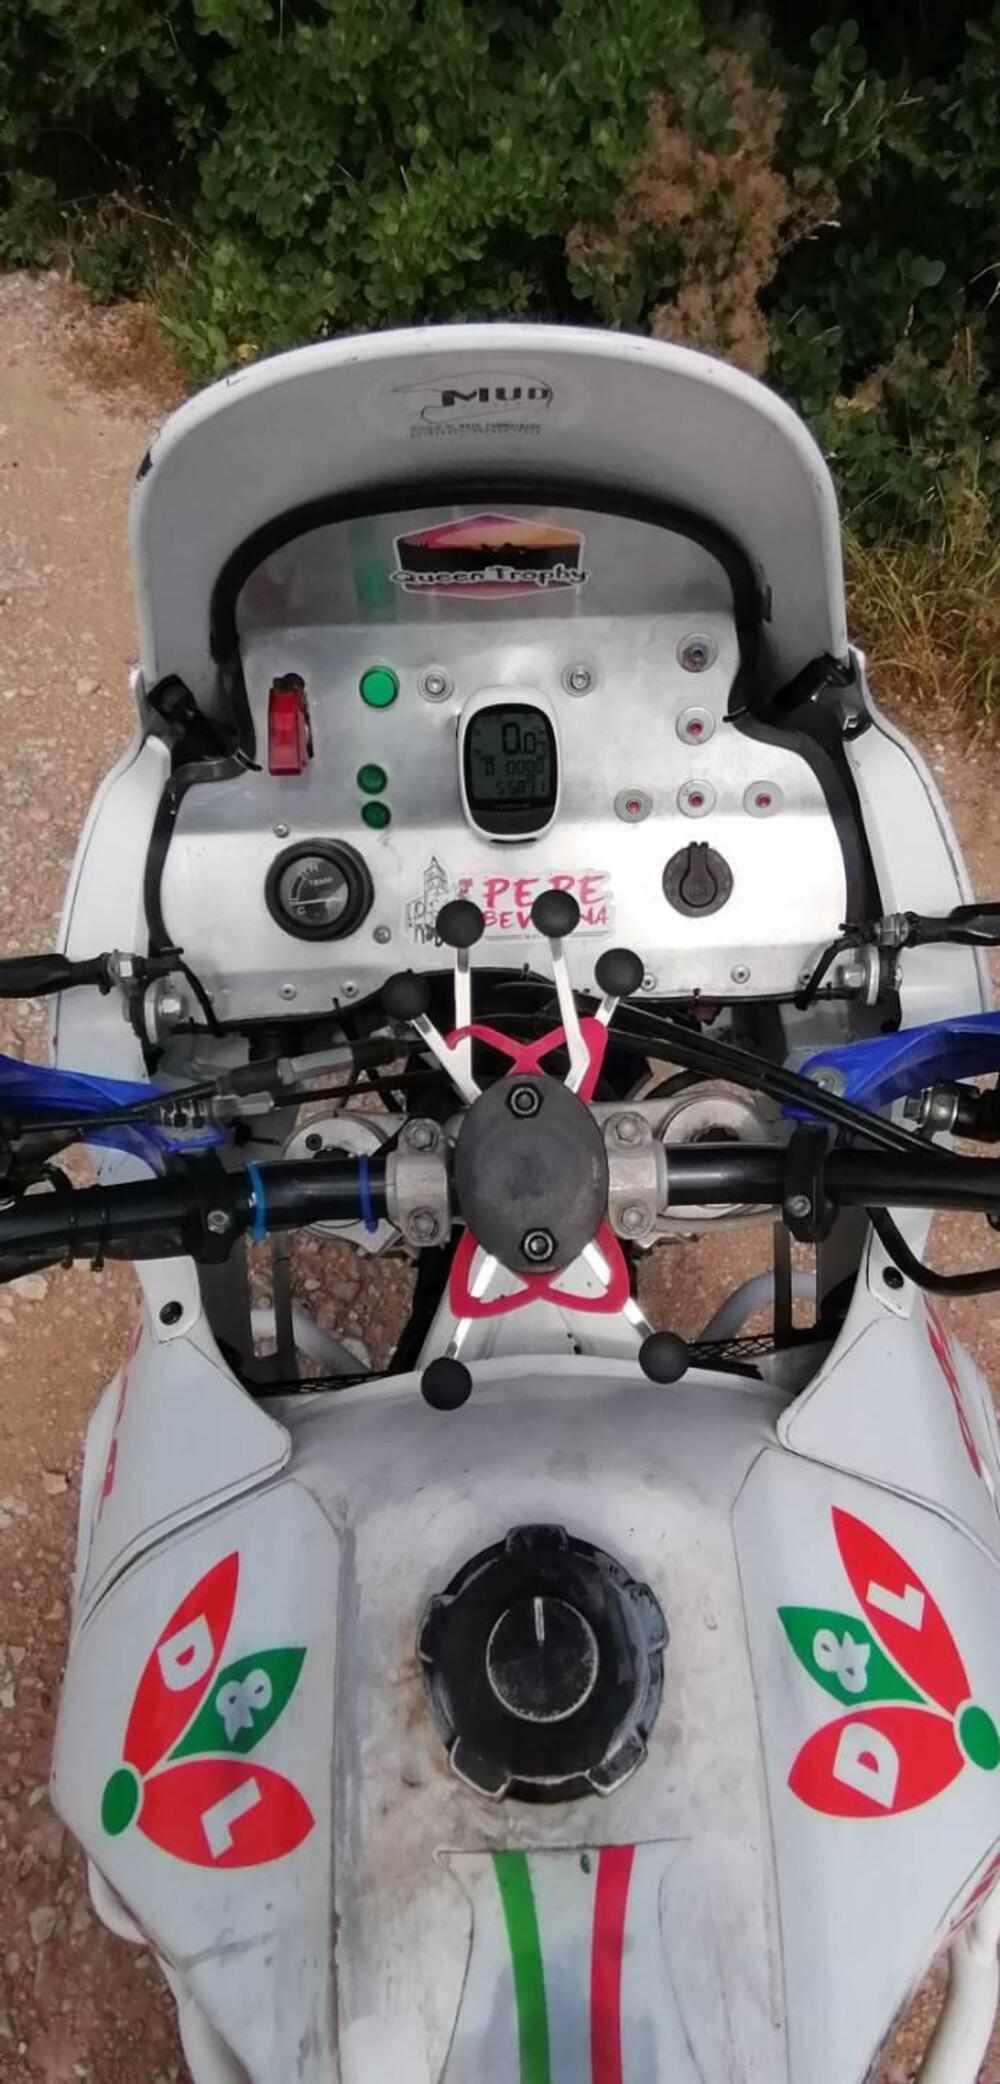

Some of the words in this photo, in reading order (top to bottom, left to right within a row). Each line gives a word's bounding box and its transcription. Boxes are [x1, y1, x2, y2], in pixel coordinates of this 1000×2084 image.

[392, 571, 484, 583] Queen
[489, 564, 587, 587] Trophy
[484, 907, 610, 930] BEVNA
[156, 1612, 215, 1692] D
[200, 1776, 262, 1861] L
[832, 1721, 899, 1809] D
[866, 1579, 926, 1632] L
